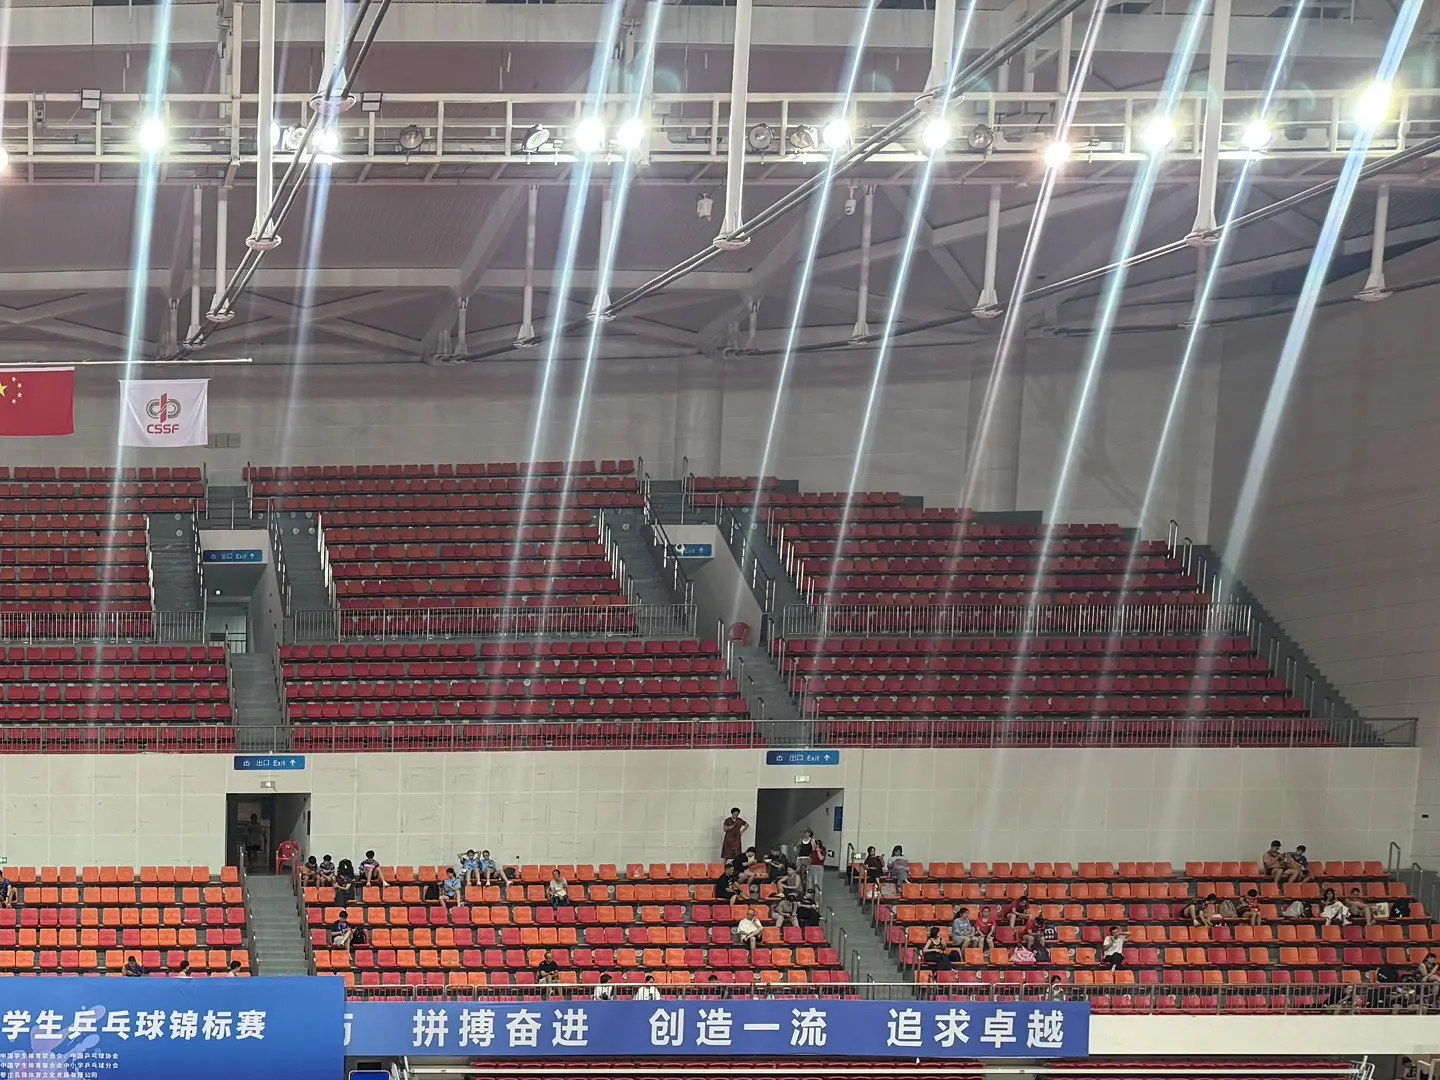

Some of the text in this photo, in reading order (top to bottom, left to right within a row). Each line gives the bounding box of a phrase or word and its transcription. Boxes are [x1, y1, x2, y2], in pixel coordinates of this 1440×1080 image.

[146, 424, 180, 434] CSSF
[413, 1008, 1063, 1048] 拼搏奋进 创造一流 追求卓越
